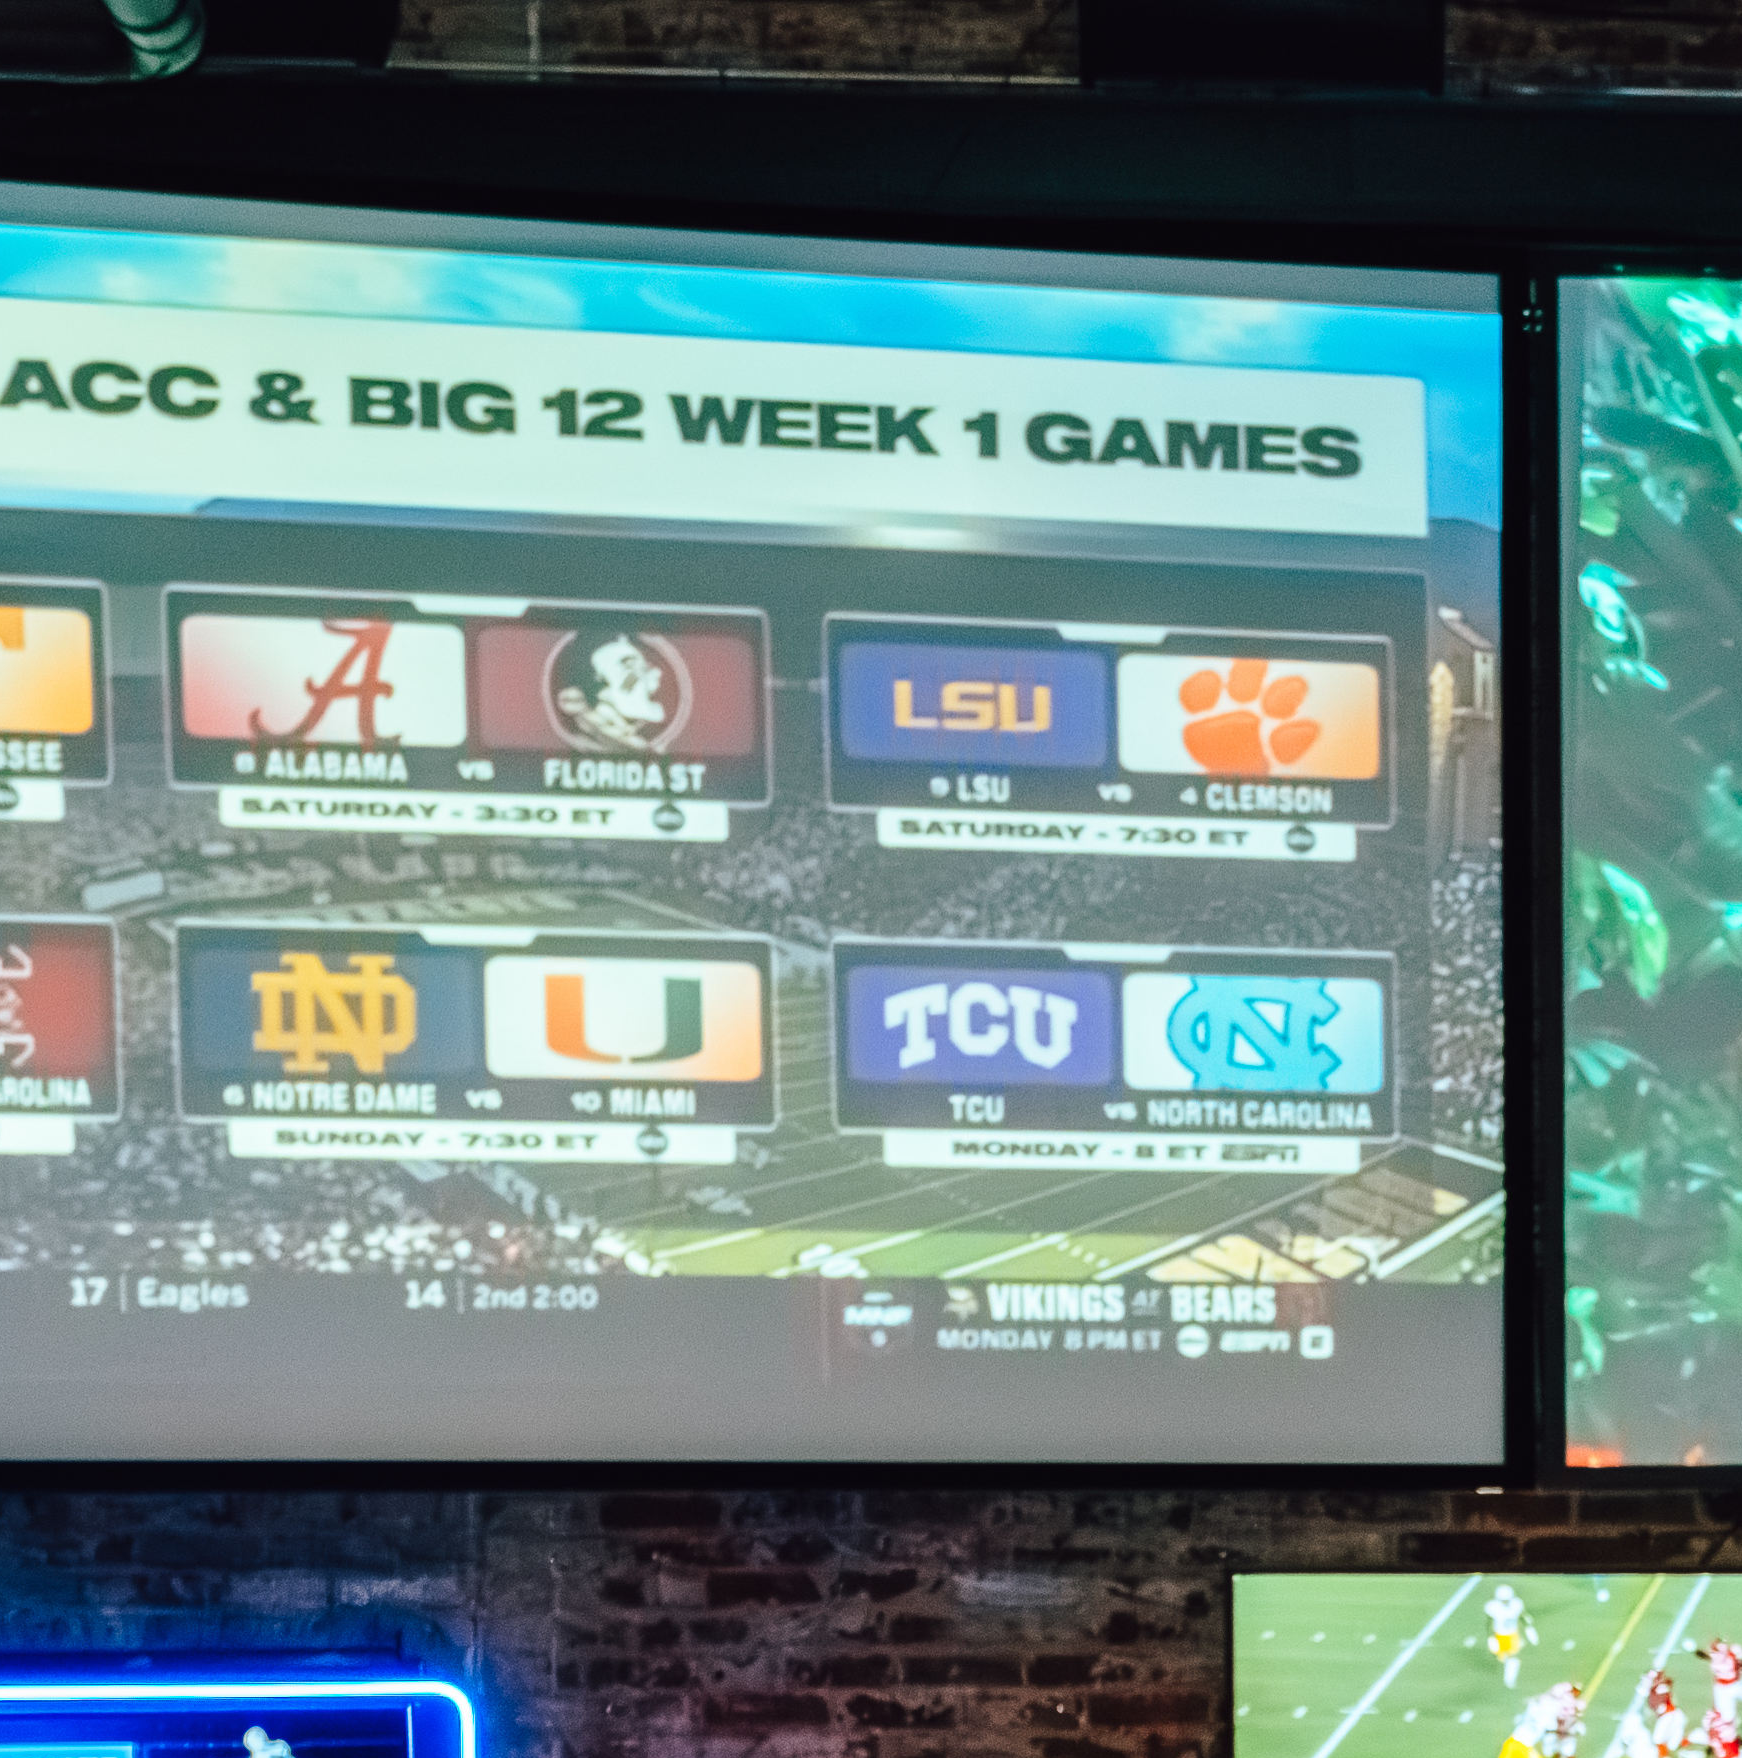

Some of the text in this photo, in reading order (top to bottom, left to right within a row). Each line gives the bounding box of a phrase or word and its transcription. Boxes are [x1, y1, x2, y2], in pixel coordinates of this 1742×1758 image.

[248, 372, 322, 425] &
[348, 376, 518, 434] BIG
[543, 389, 645, 441] 12
[669, 394, 941, 457] WEEK
[963, 411, 999, 459] 1
[1025, 412, 1364, 478] GAMES
[892, 678, 1052, 732] LSU
[264, 749, 707, 792] ALABAMA FLORIDA ST
[957, 773, 1010, 803] LSU
[1205, 783, 1333, 813] CLEMSON
[240, 797, 438, 824] SATURDAY
[569, 807, 616, 827] ET
[898, 816, 1085, 844] SATURDAY
[1207, 828, 1251, 847] ET
[543, 973, 704, 1066] U
[884, 981, 1079, 1069] TCU
[253, 1081, 349, 1112] NOTRE
[356, 1083, 437, 1114] DAME
[609, 1088, 697, 1117] MIAMI
[949, 1094, 1374, 1129] TCU NORTH CAROLINA
[274, 1127, 599, 1151] SUNDAY 7:30 ET
[952, 1140, 1101, 1161] MONDAY
[1166, 1144, 1210, 1162] ET
[69, 1277, 108, 1307] 17
[137, 1282, 250, 1313] Eagles
[404, 1281, 446, 1309] 14
[472, 1283, 527, 1309] 2nd
[532, 1283, 600, 1310] 2:00
[986, 1283, 1277, 1323] VIKINGS BEARS
[936, 1329, 1054, 1350] MONDAY
